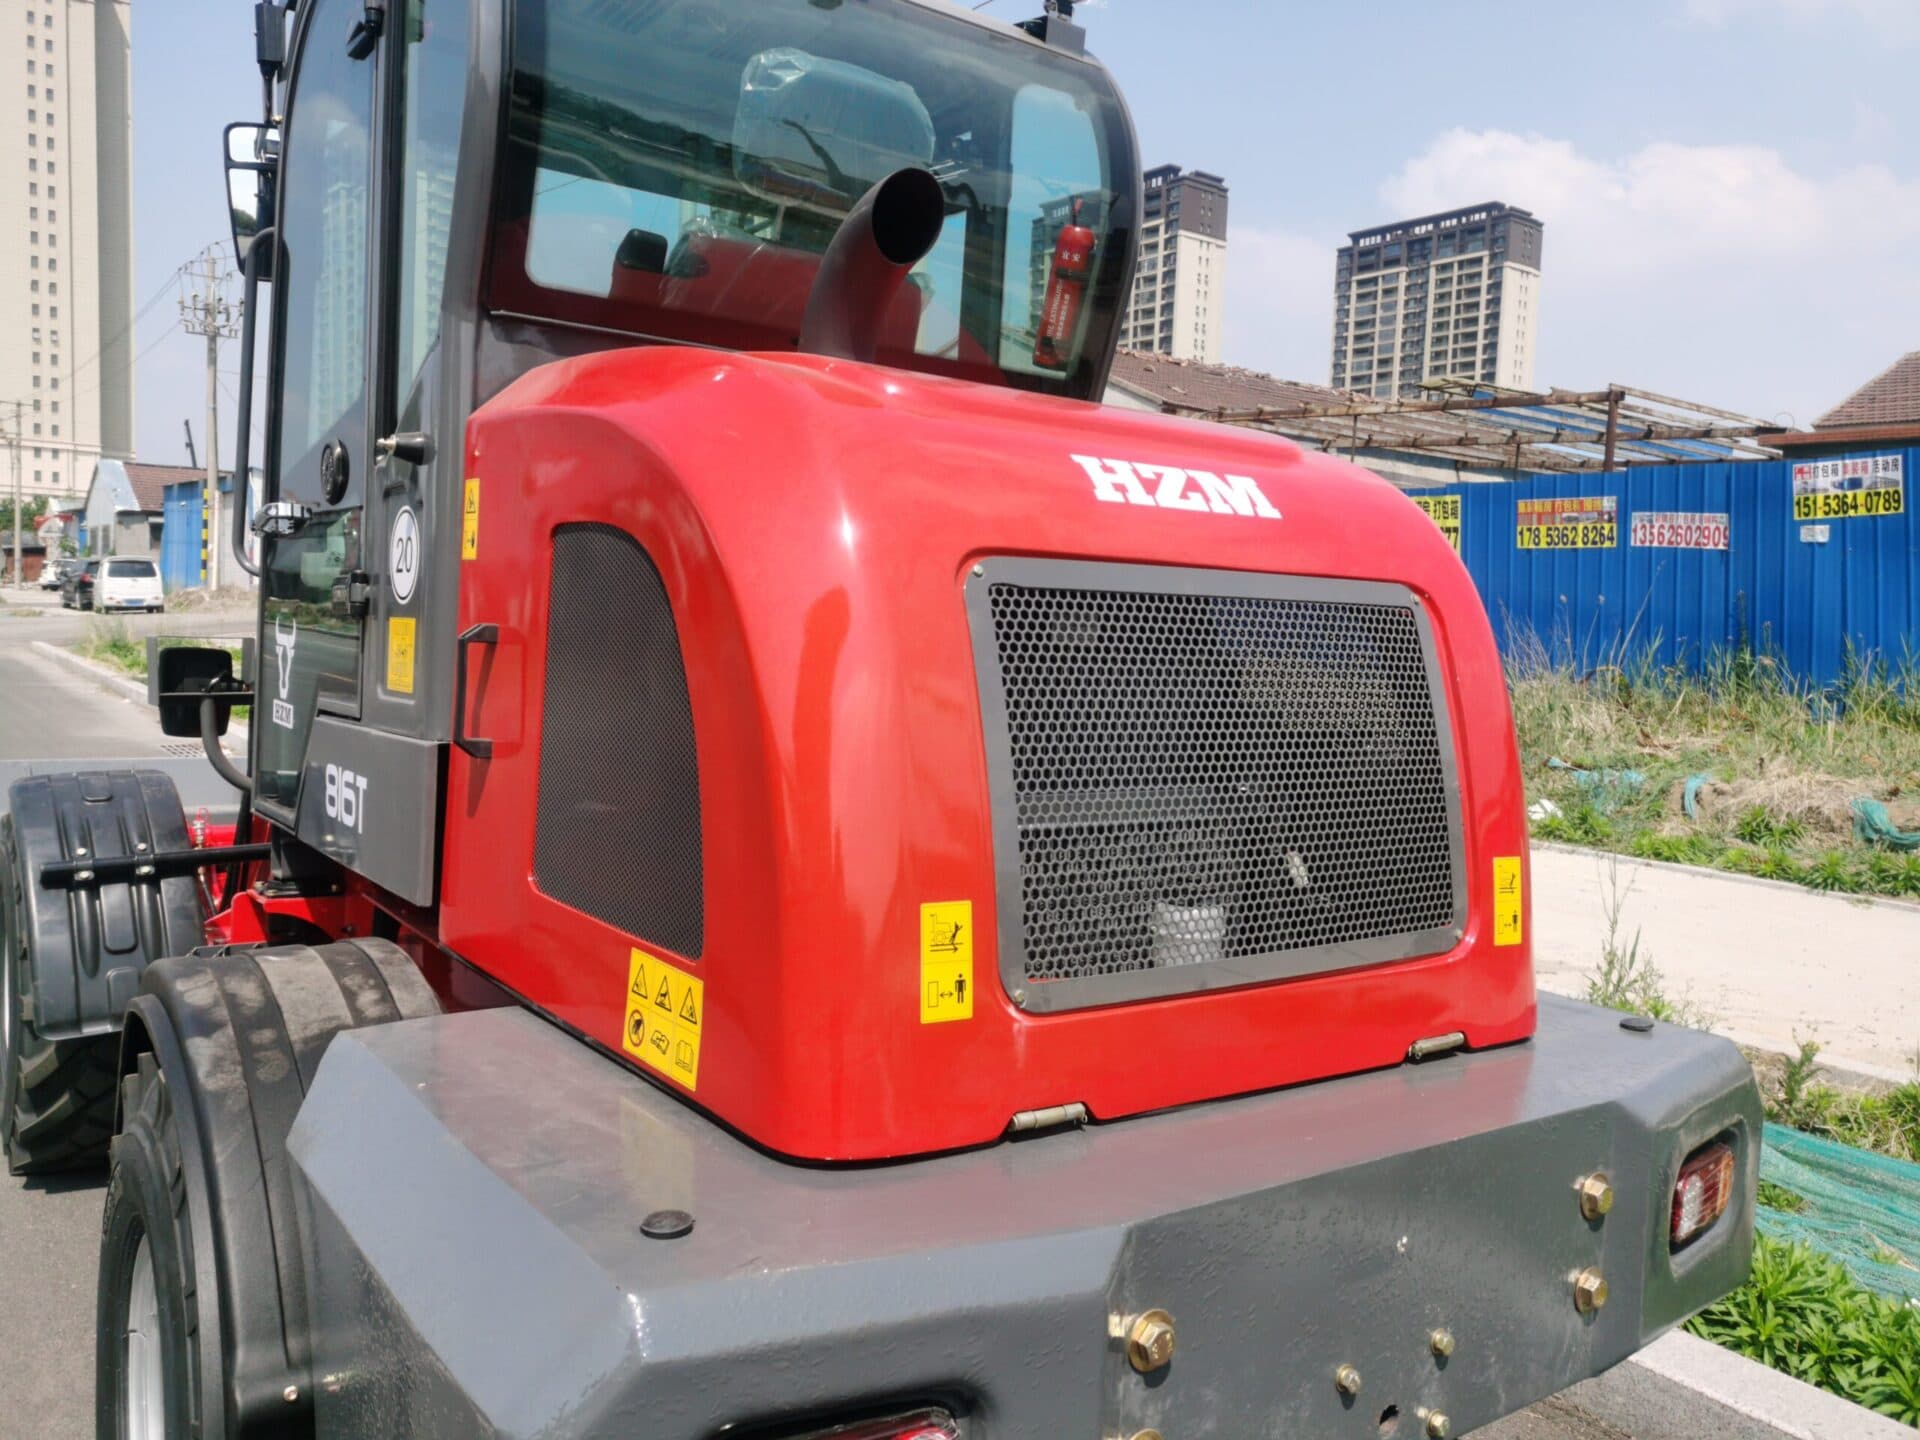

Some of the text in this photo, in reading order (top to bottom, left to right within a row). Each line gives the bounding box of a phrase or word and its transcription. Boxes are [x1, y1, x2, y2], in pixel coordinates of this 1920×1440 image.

[1070, 454, 1282, 519] HZM
[1795, 489, 1901, 518] 151-5364-0789
[1518, 525, 1615, 546] 178 5362 8264
[396, 537, 413, 573] 20
[325, 763, 368, 834] 816T
